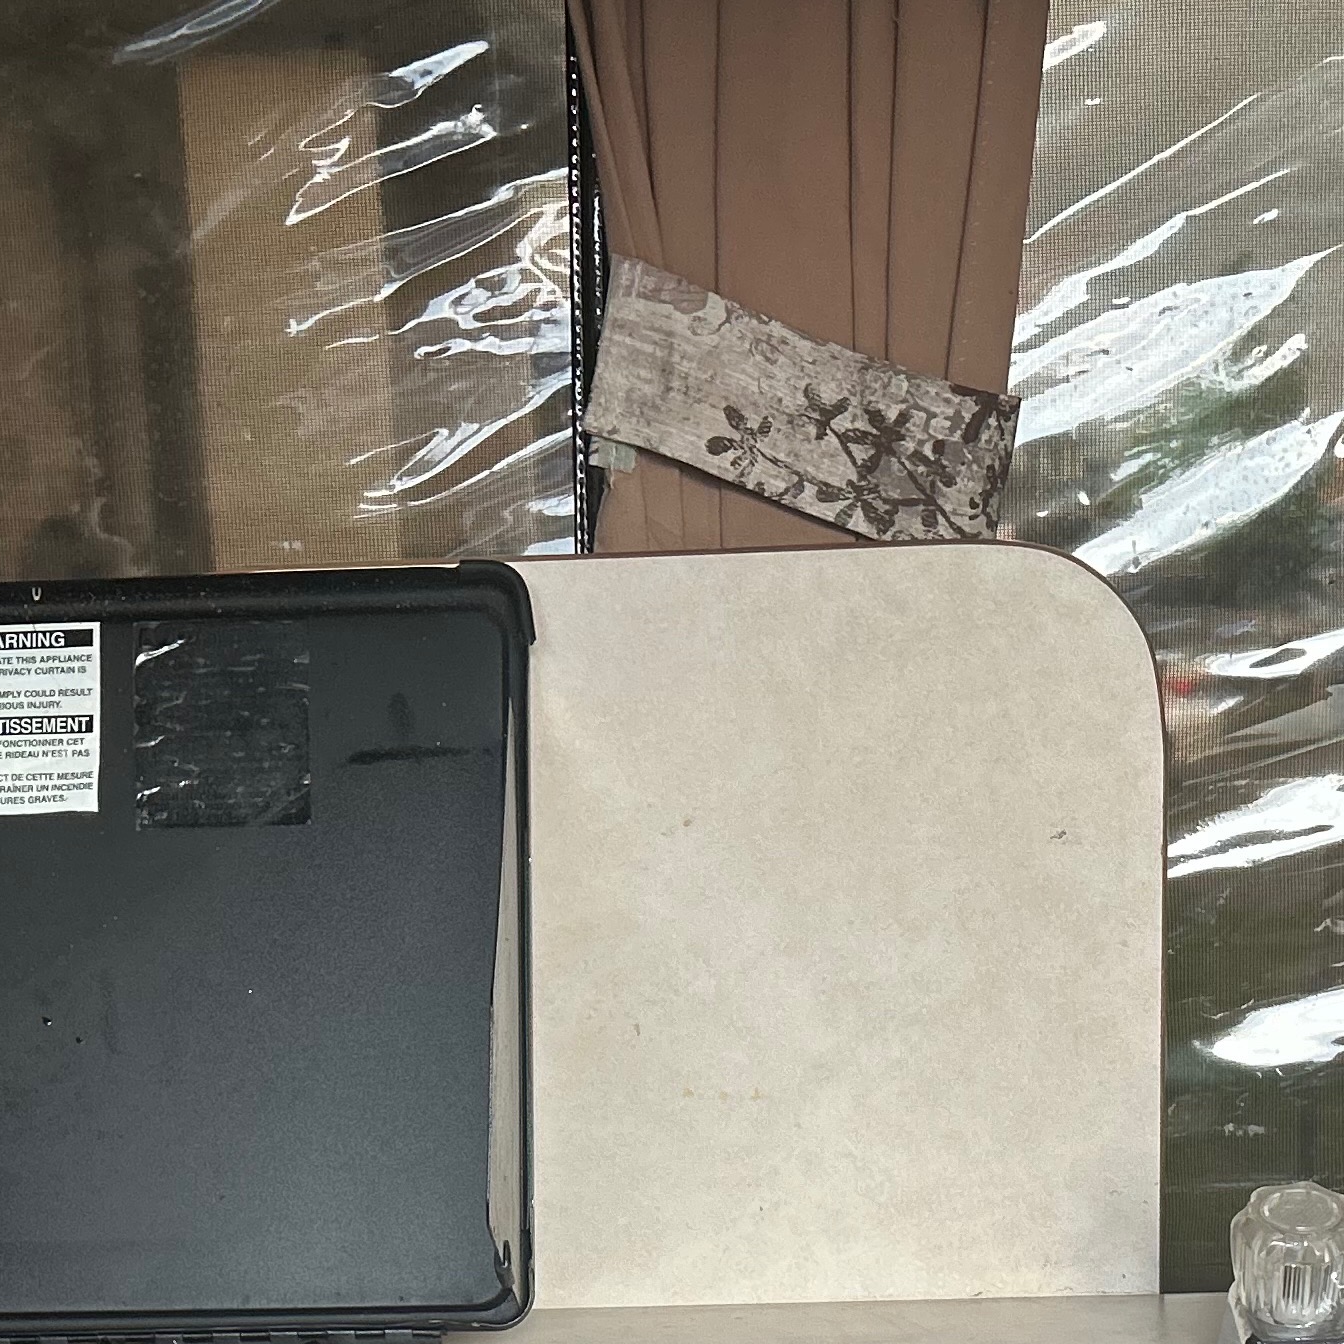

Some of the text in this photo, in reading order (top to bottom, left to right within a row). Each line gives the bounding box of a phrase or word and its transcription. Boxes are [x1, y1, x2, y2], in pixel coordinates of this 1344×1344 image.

[16, 655, 37, 665] THIS
[39, 654, 93, 664] APPLIANCE
[34, 666, 75, 675] CURTAIN
[77, 665, 87, 674] IS
[24, 689, 56, 698] COULD
[57, 688, 94, 697] RESULT
[26, 700, 63, 709] INJURY.
[66, 737, 86, 746] CET
[5, 750, 40, 759] RIDEAU
[41, 749, 68, 758] N'EST
[71, 748, 91, 758] PAS
[11, 773, 24, 782] DE
[25, 772, 55, 782] CETTE
[56, 770, 95, 781] MESURE
[36, 784, 49, 793] UN
[51, 782, 94, 792] INCENDIE
[27, 794, 68, 804] GRAVES.
